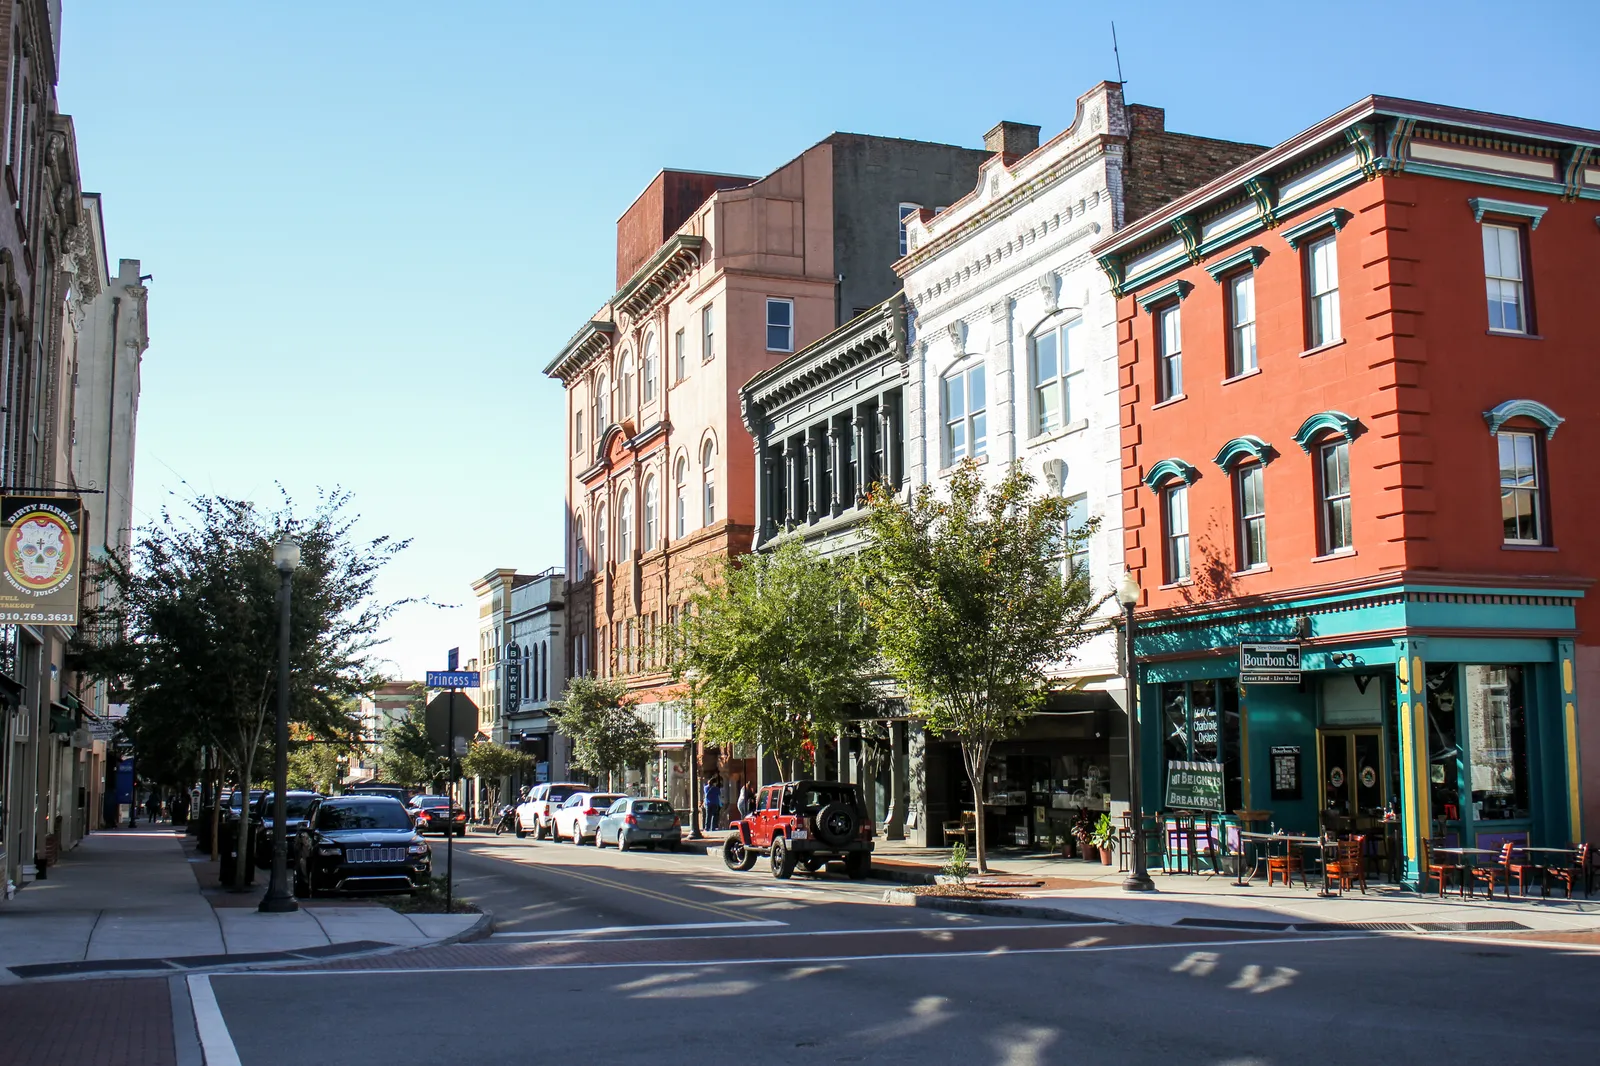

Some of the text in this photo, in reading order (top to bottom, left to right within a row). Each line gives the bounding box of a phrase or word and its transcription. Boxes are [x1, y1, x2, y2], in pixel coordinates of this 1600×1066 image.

[7, 503, 78, 531] DIRTY HARRY'S
[3, 570, 73, 598] BURRITO JUICE BAR
[0, 612, 74, 621] 910.769.3631
[1244, 653, 1299, 667] Bourbon St.
[428, 673, 469, 686] Princess
[508, 650, 518, 708] BREWERY
[1171, 772, 1221, 787] HOT BEIGNETS
[1170, 792, 1218, 807] BREAKFAST
